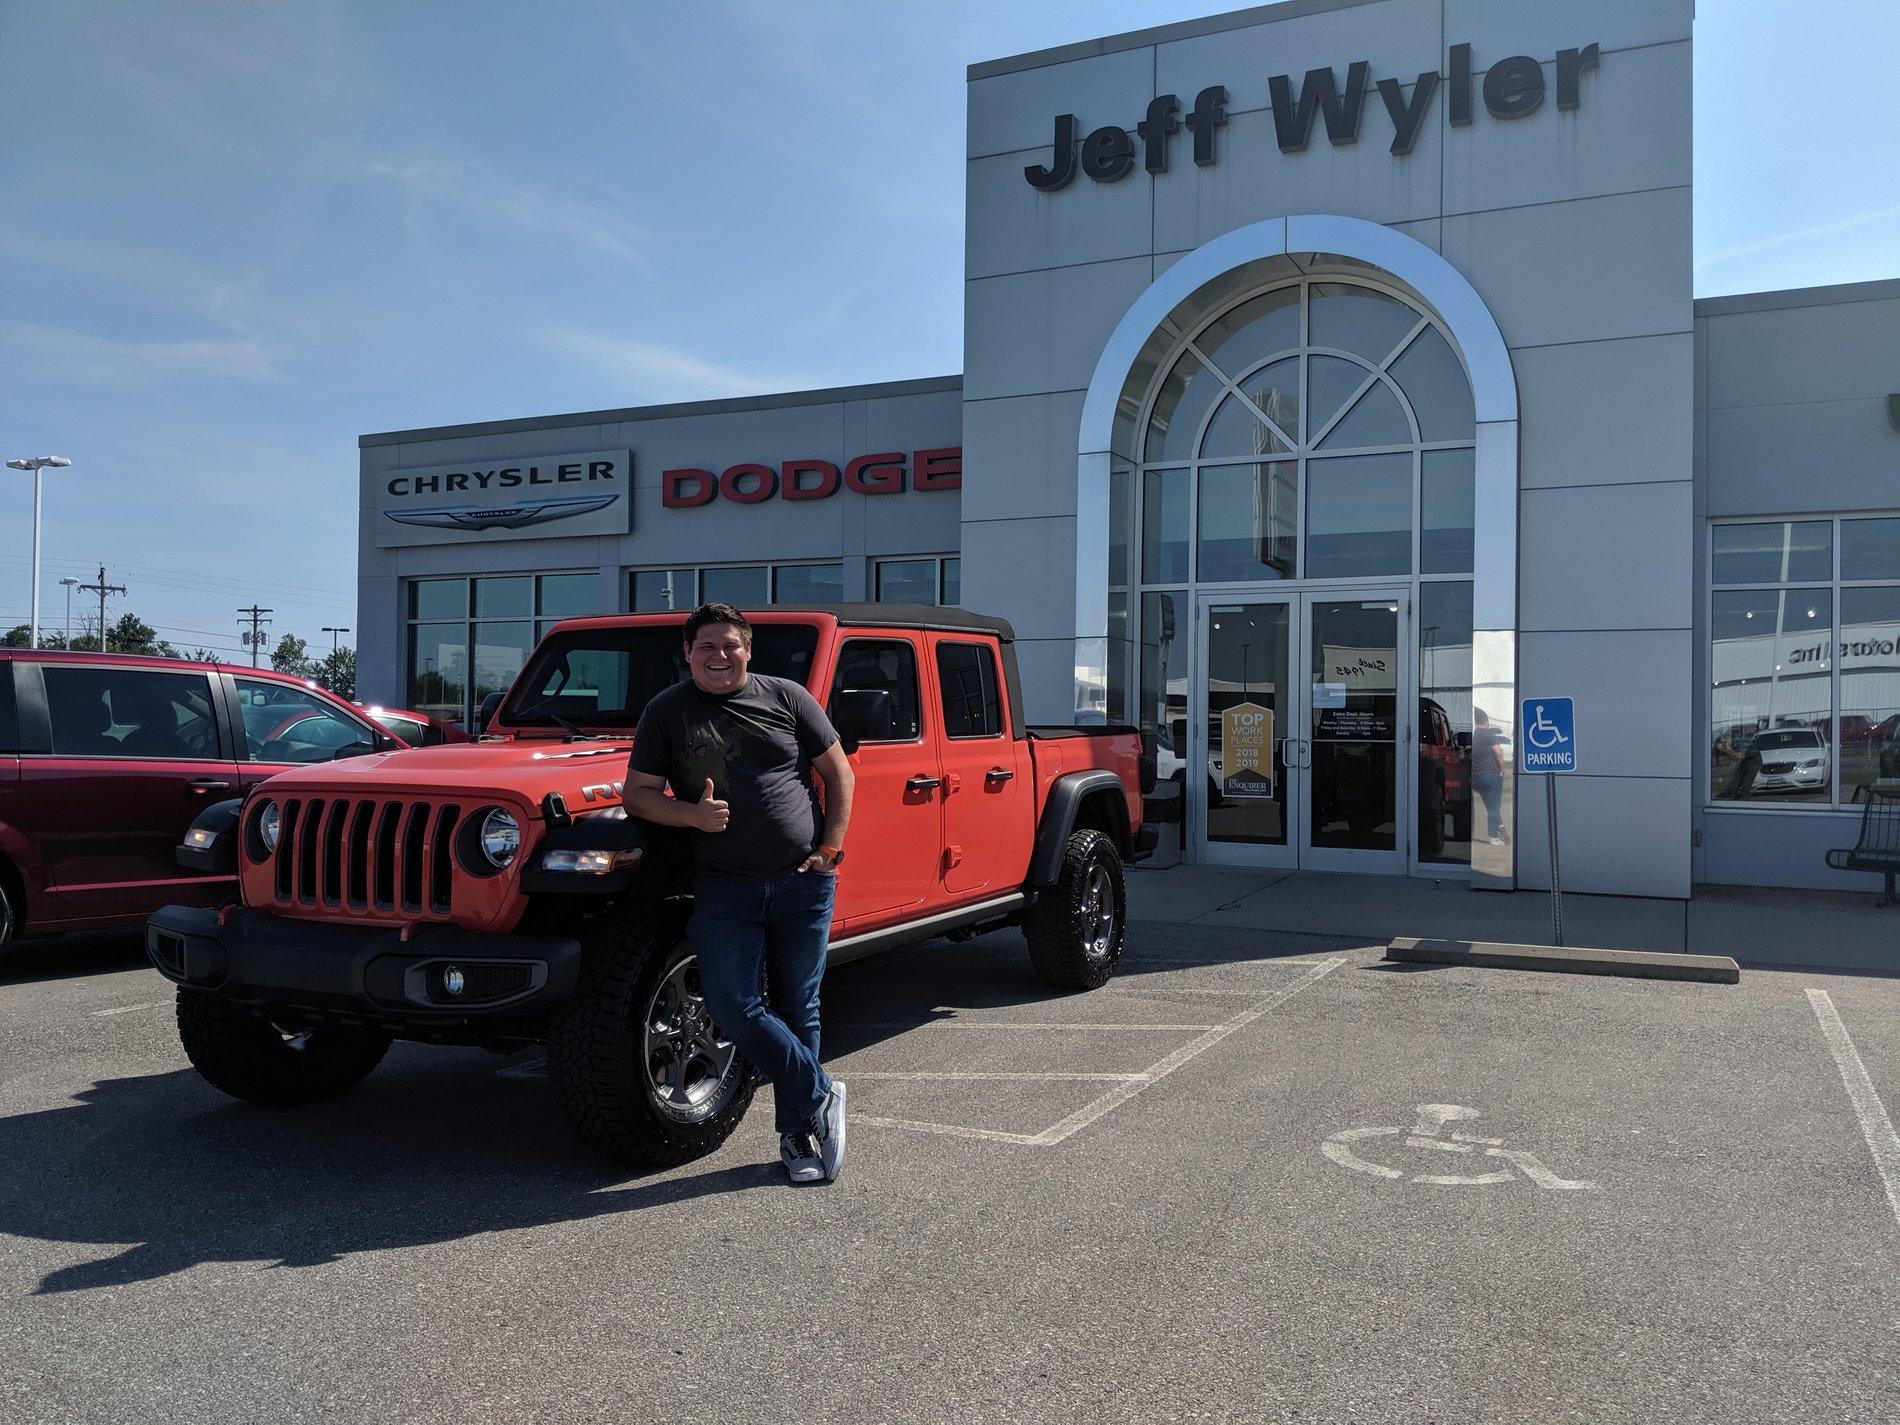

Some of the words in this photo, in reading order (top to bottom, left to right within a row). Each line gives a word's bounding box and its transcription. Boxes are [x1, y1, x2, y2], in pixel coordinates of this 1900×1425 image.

[1024, 85, 1229, 193] Jeff
[1268, 42, 1600, 156] Wyler
[387, 461, 615, 496] CHRYSLER
[662, 447, 962, 508] DODGE
[471, 510, 517, 518] CHRYSLER
[1231, 713, 1264, 726] TOP
[1231, 726, 1264, 736] WORK
[1230, 736, 1264, 745] PLACES
[1235, 748, 1259, 757] 2018
[1235, 759, 1259, 767] 2019
[1527, 752, 1573, 765] PARKING
